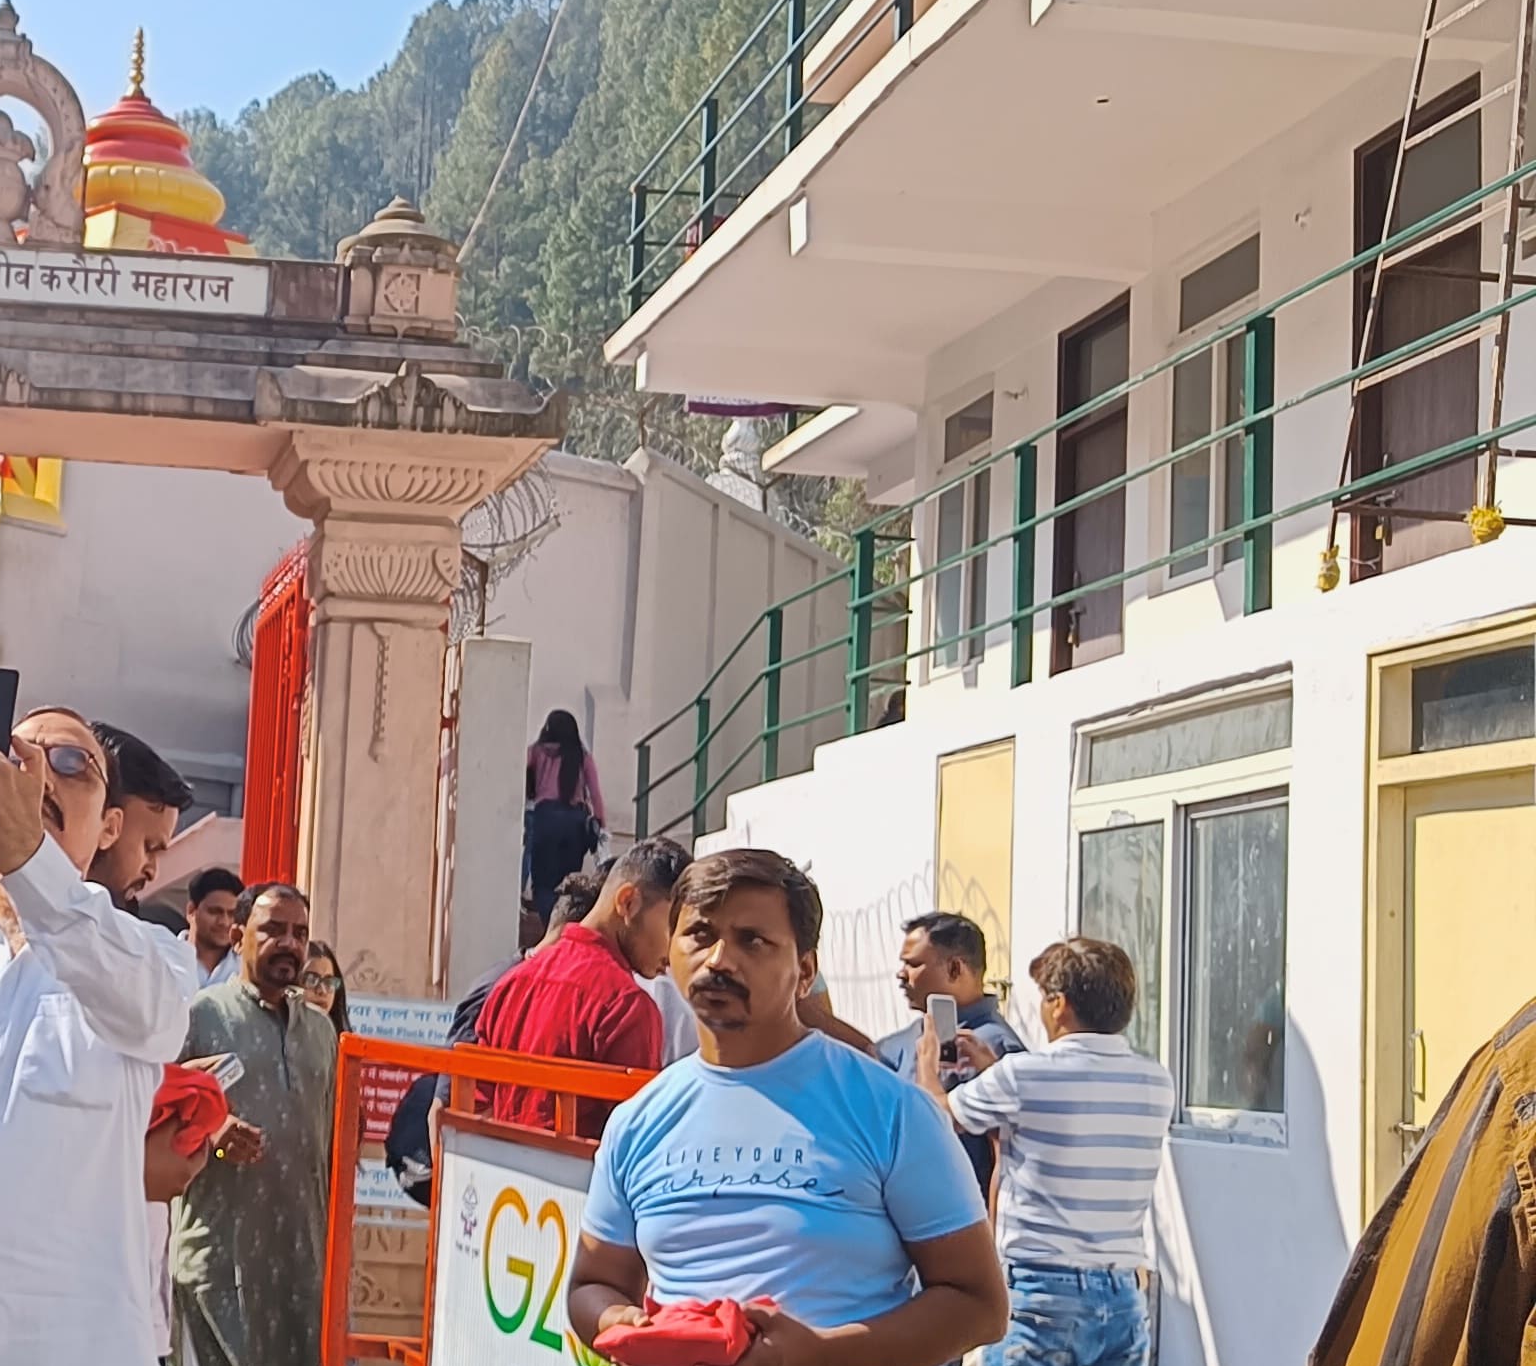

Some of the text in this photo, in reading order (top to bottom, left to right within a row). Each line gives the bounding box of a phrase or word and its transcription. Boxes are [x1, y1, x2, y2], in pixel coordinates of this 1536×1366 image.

[131, 270, 234, 303] महाराज
[666, 1147, 804, 1165] LIVE YOUR
